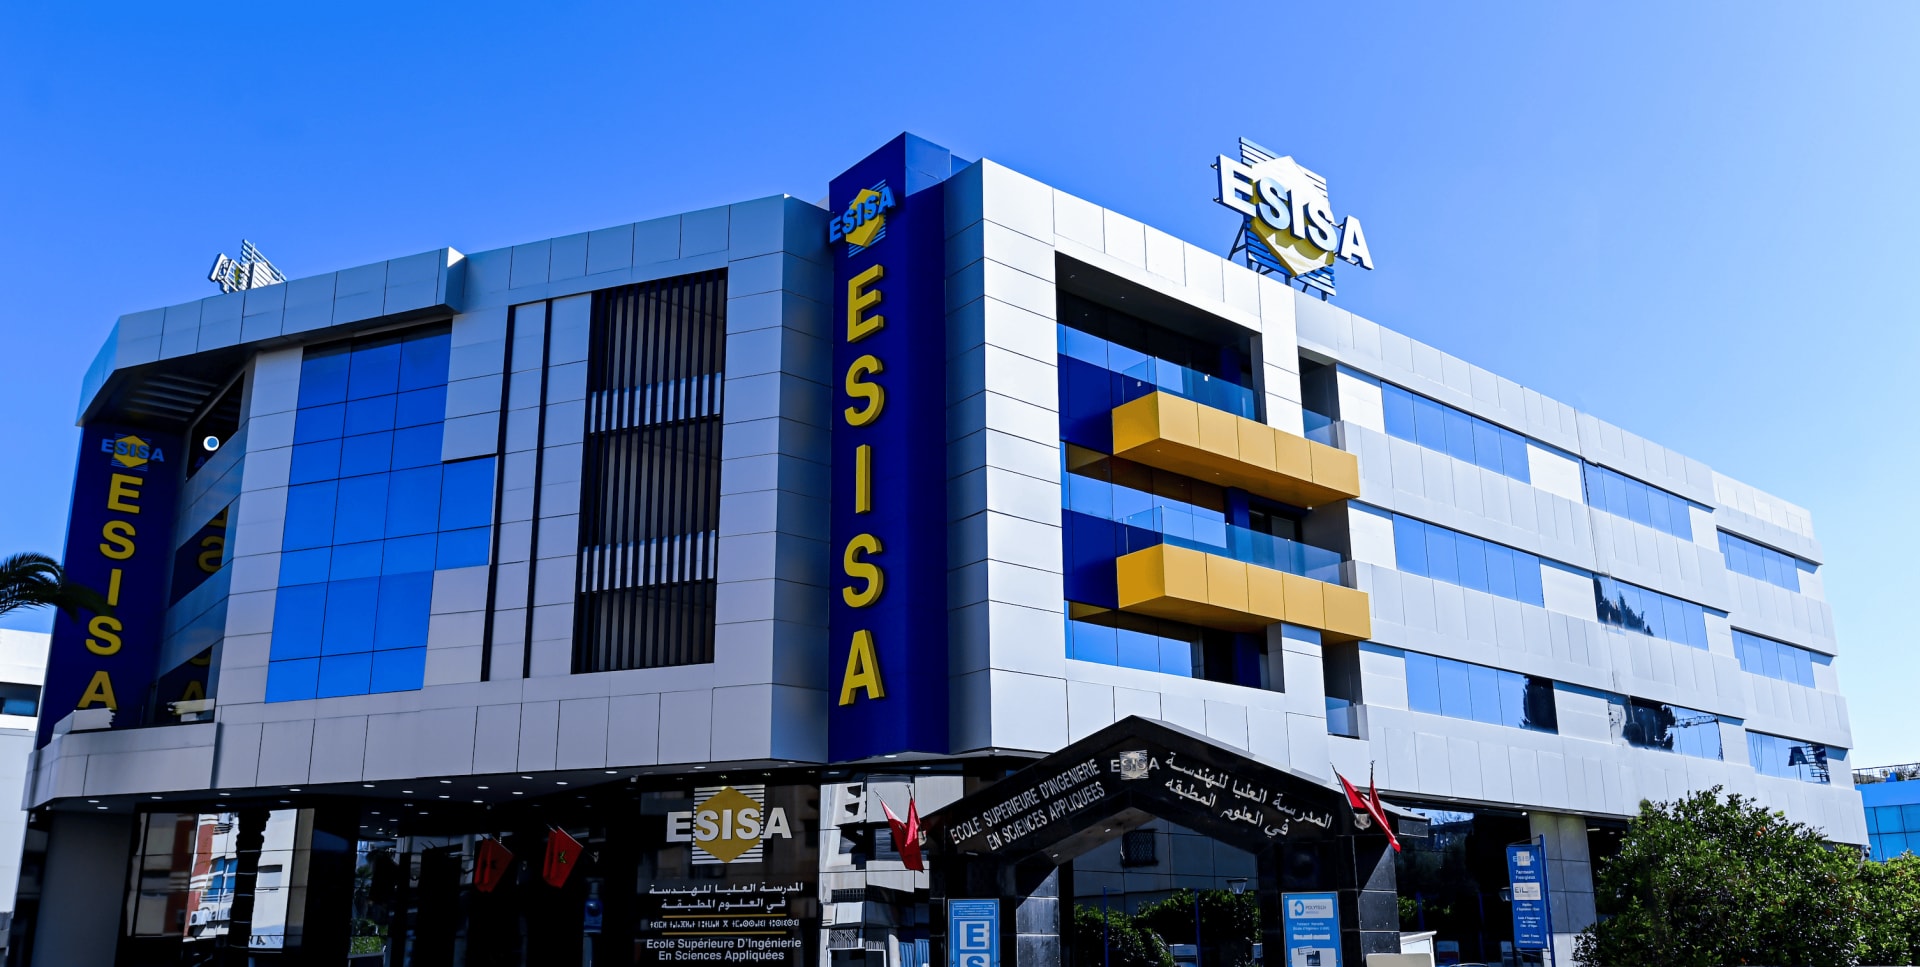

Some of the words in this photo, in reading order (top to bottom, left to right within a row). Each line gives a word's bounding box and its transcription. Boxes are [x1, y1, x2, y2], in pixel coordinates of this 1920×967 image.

[829, 186, 896, 244] ESISA
[1216, 153, 1374, 271] ESISA
[101, 438, 164, 462] ESISA
[839, 264, 885, 707] ESISA
[77, 473, 143, 711] ESISA
[1165, 752, 1228, 788] للهندسة
[950, 817, 982, 844] ECOLE
[983, 788, 1041, 828] SUPERIEURE
[1039, 758, 1100, 799] D'INGENIERIE
[1232, 779, 1267, 803] العليا
[986, 830, 1003, 850] EN
[1002, 809, 1048, 843] SCIENCES
[1049, 781, 1105, 822] APPLIQUEES
[1220, 805, 1263, 827] العلوم
[1272, 793, 1333, 829] المدرسة
[666, 807, 792, 842] ESISA
[1264, 818, 1289, 838] في
[649, 884, 712, 897] للهندسة
[714, 883, 756, 895] العليا
[759, 881, 804, 895] المدرسة
[661, 899, 716, 911] المطبقة
[718, 898, 764, 911] العلوم
[766, 896, 786, 913] في
[646, 938, 675, 948] Ecole
[677, 938, 735, 950] Supérieure
[737, 937, 802, 950] D'Ingénierie
[658, 951, 672, 960] En
[675, 950, 722, 960] Sciences
[724, 949, 785, 962] Appliquées
